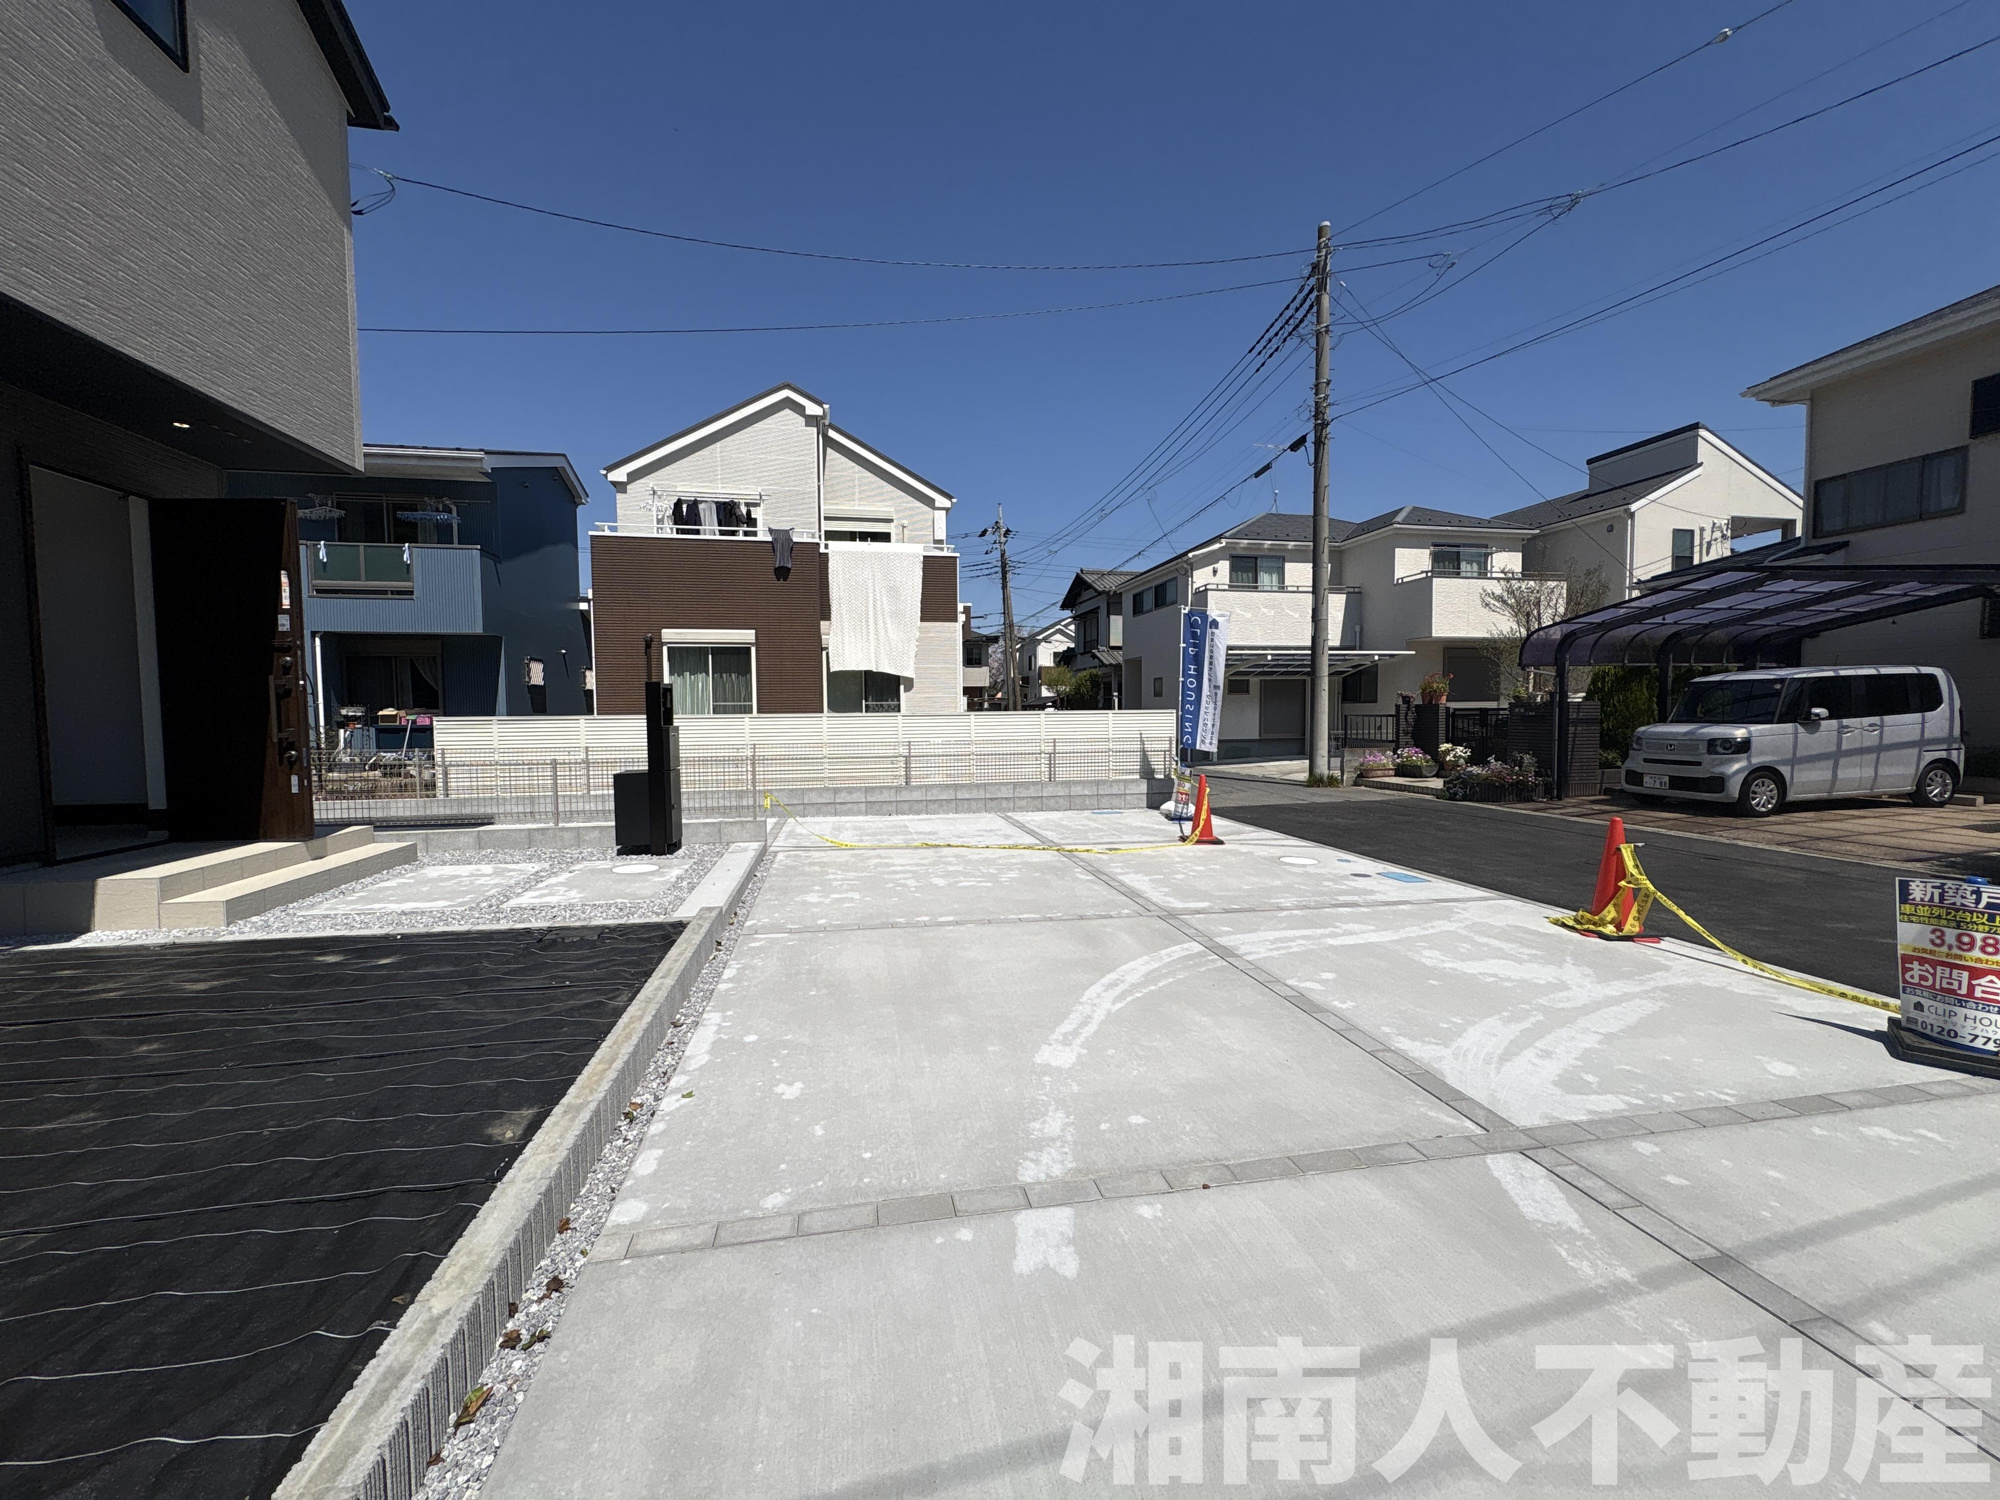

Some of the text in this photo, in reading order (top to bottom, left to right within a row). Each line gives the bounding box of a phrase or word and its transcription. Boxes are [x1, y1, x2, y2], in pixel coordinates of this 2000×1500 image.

[1905, 961, 2000, 1001] お問合
[1927, 1004, 1958, 1019] CLIP
